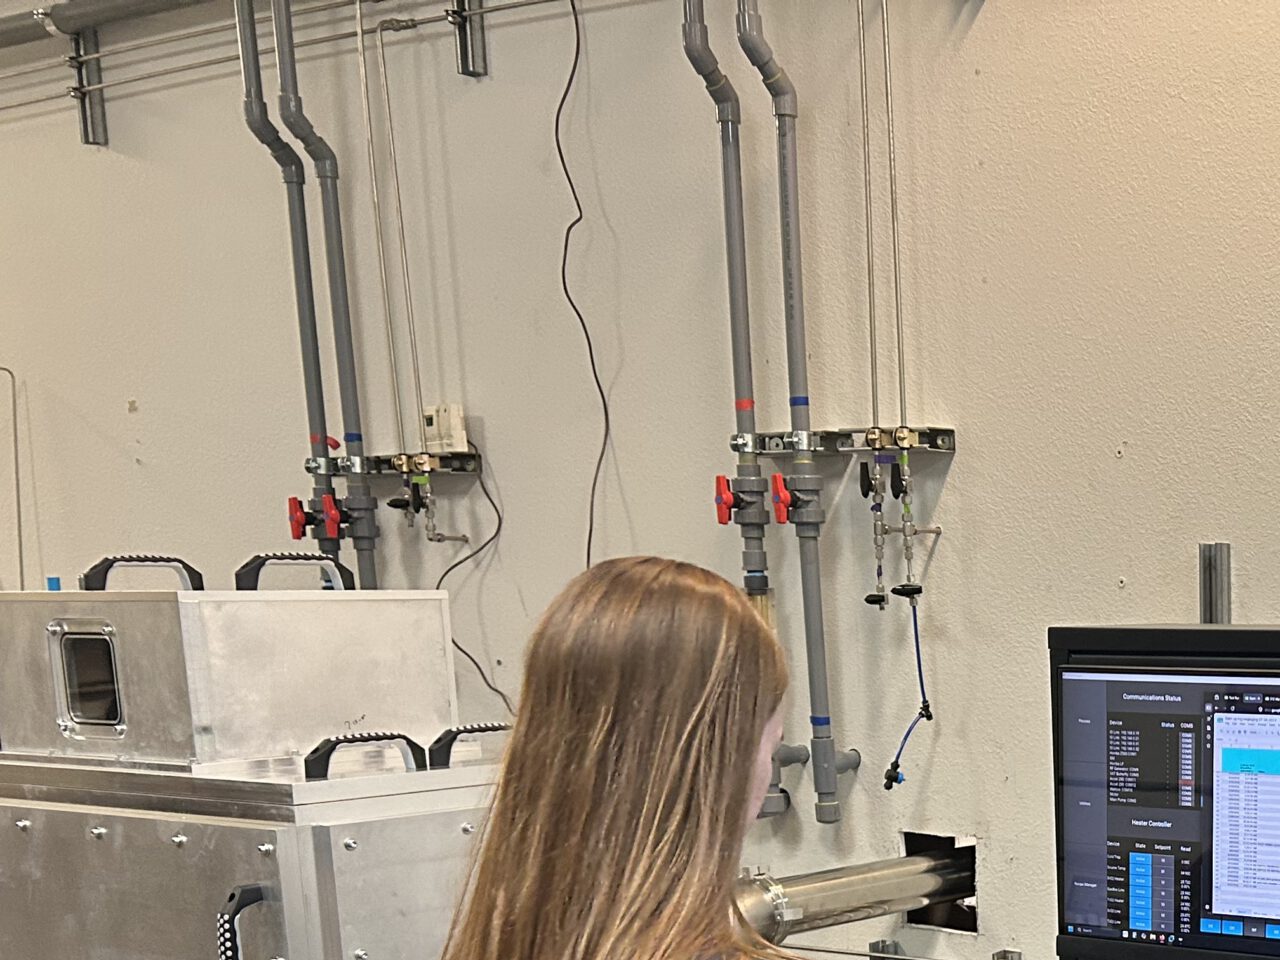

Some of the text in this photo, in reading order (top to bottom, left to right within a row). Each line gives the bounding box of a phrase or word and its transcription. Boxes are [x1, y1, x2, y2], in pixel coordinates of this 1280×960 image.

[1122, 693, 1181, 702] Communications Status
[1131, 819, 1172, 828] Heater Controller
